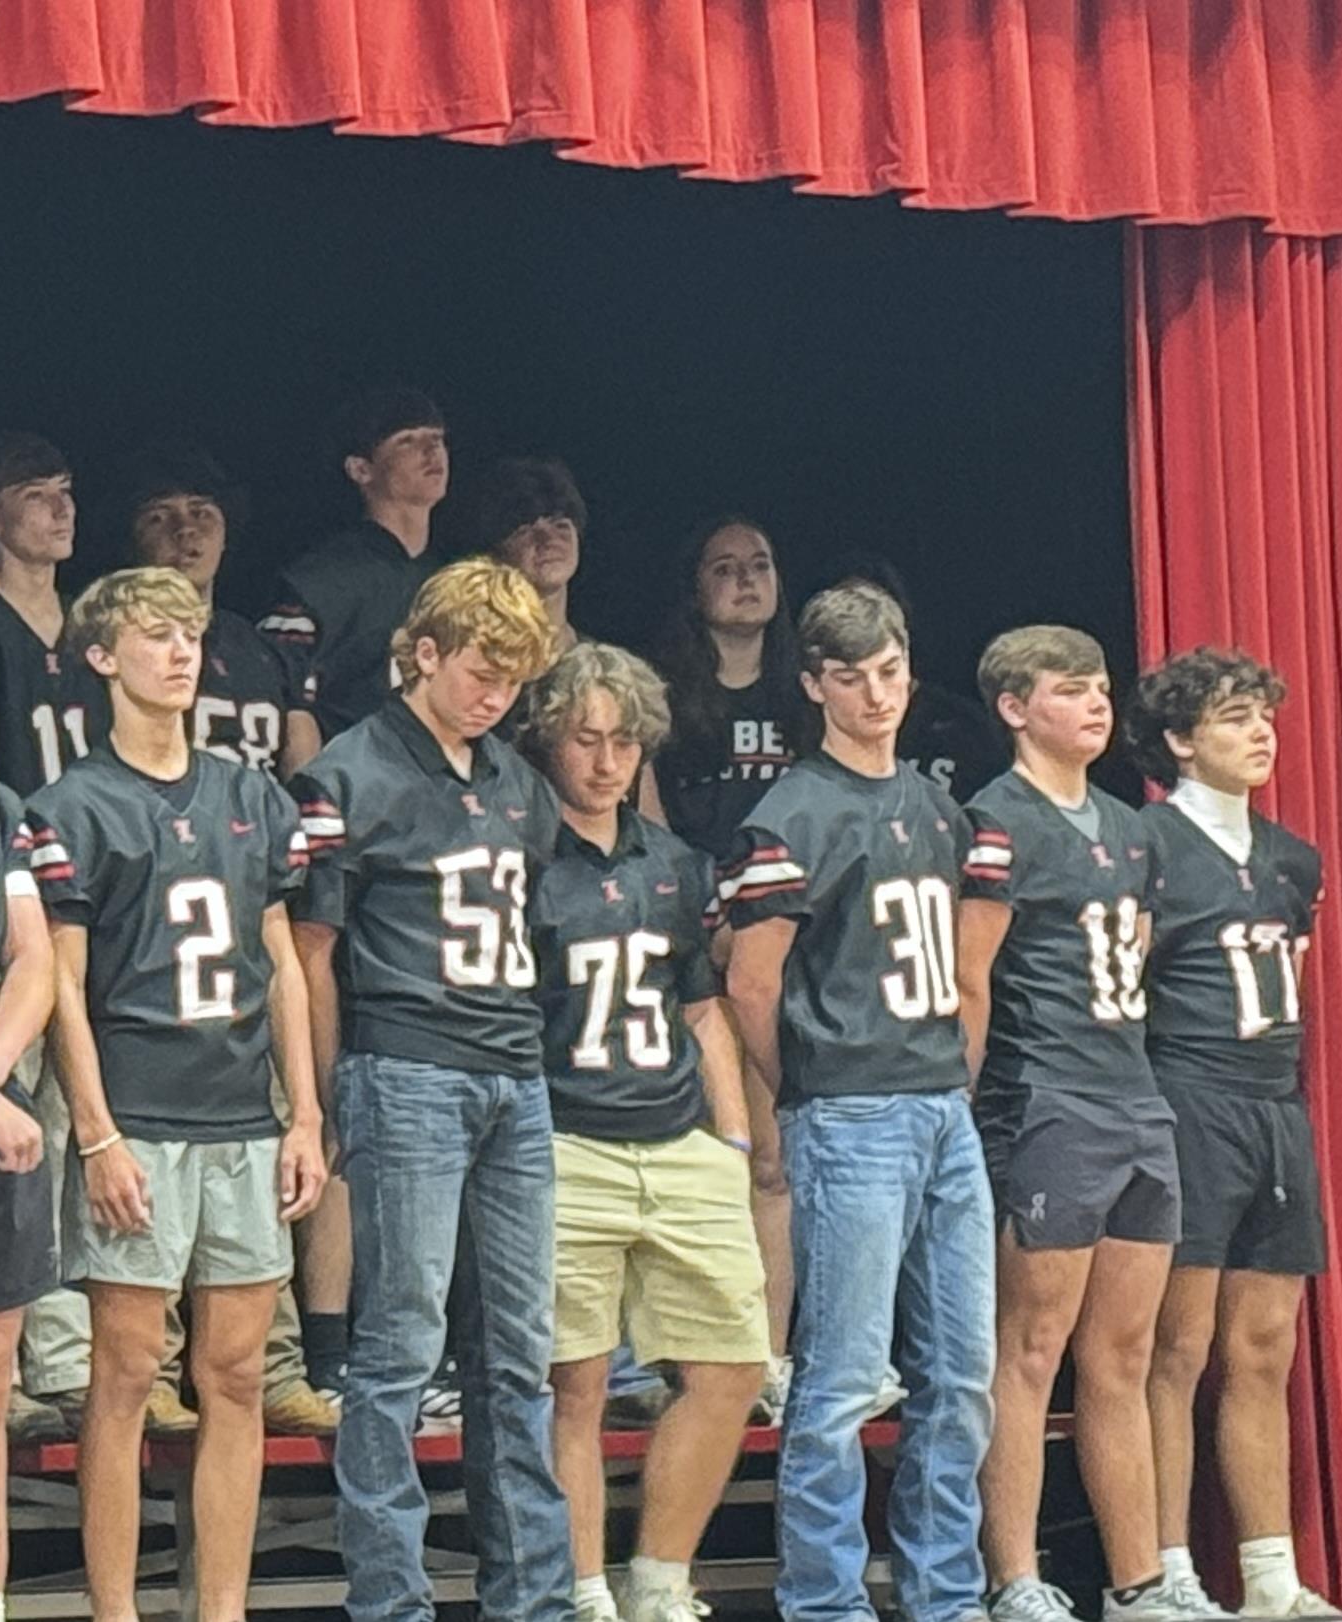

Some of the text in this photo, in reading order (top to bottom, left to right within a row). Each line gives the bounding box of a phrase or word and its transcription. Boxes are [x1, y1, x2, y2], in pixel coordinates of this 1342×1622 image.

[168, 878, 235, 1022] 2
[434, 847, 536, 987] 53
[873, 878, 961, 1020] 30
[567, 931, 671, 1070] 75
